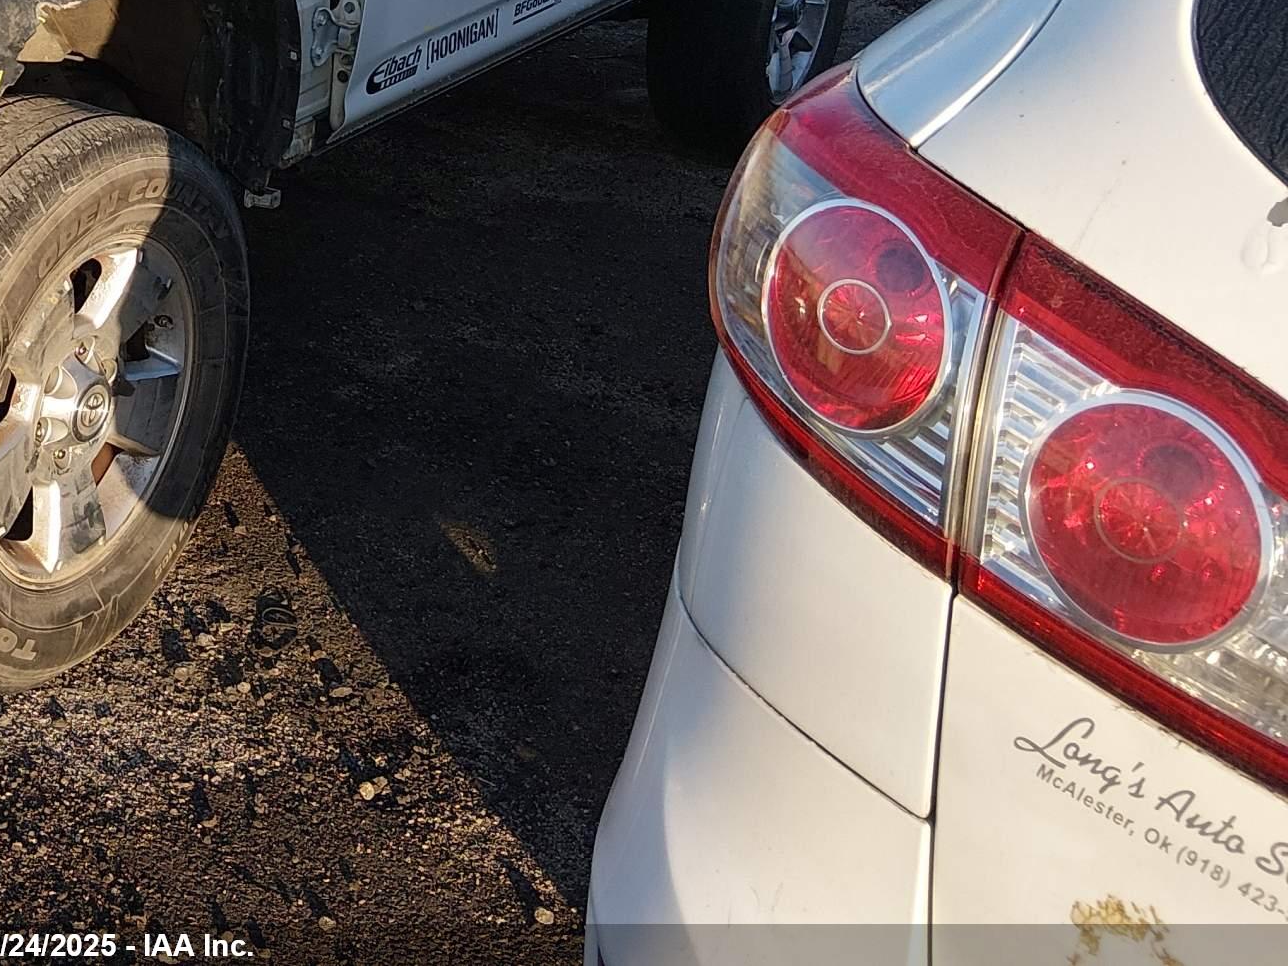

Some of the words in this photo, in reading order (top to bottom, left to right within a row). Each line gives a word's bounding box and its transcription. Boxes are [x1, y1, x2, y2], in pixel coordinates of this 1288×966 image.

[366, 44, 422, 94] Eibach
[1013, 717, 1147, 798] Long's
[1153, 789, 1247, 855] Auto
[1035, 763, 1135, 837] McAlester,
[1143, 827, 1174, 854] Ok
[1176, 845, 1231, 890] (918)
[1237, 882, 1288, 922] 423-
